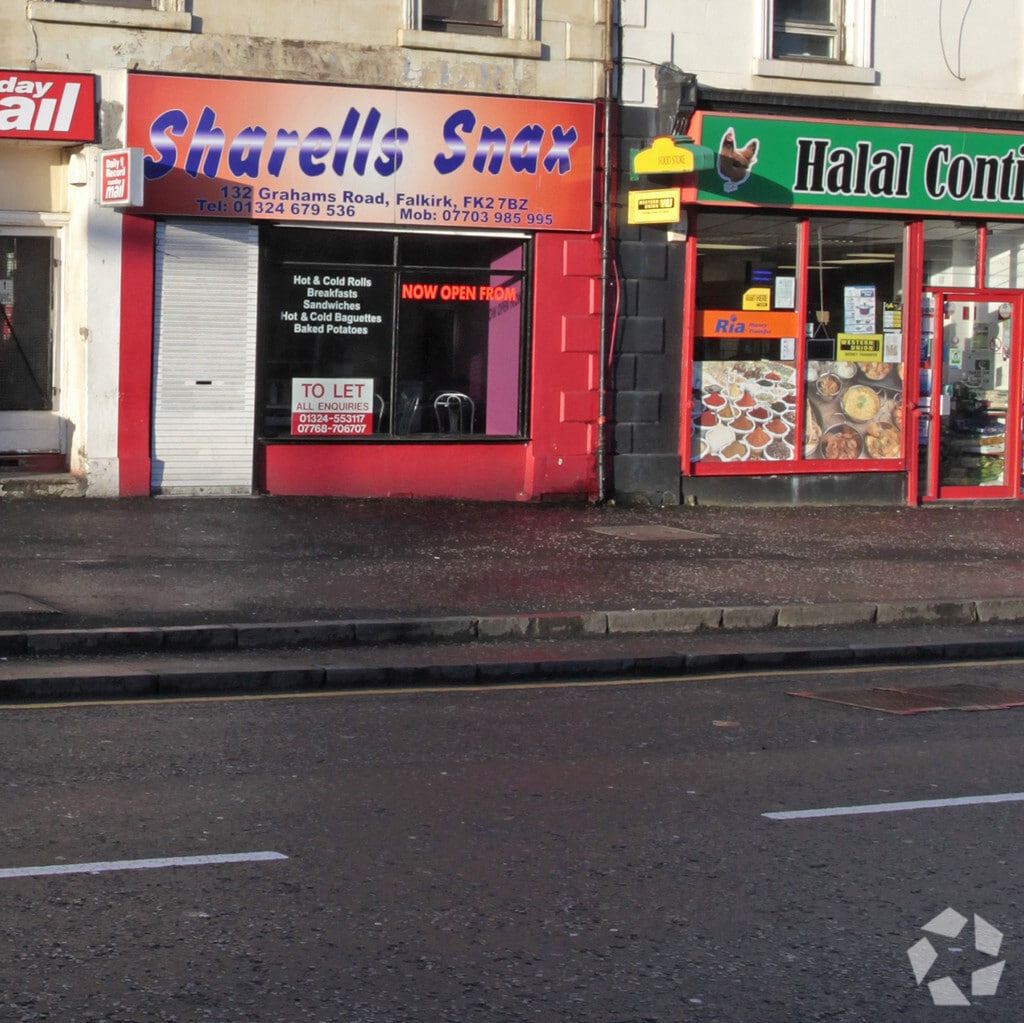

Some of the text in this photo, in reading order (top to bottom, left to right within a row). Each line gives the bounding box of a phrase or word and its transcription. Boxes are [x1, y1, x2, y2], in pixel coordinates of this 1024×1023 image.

[144, 105, 578, 177] Sharells Snax
[793, 137, 913, 198] Halal
[221, 186, 528, 211] 132 Grahams Road, Falkirk, FK2 7BZ
[197, 199, 356, 218] Tel: 01324 679 536
[400, 208, 553, 225] Mob: 07703 985 995
[293, 275, 372, 287] Hot & Cold Rolls
[307, 287, 358, 298] Breakfasts
[401, 284, 517, 302] NOW OPEN FROM
[303, 299, 361, 311] Sandwiches
[280, 311, 382, 325] Hot & Cold Baguettes
[715, 316, 745, 334] Ria
[293, 323, 368, 335] Baked Potatoes
[301, 383, 365, 398] TO LET
[296, 402, 369, 411] ALL ENQUIRIES
[299, 414, 365, 423] 01324-553117
[297, 424, 367, 433] 07768-706707
